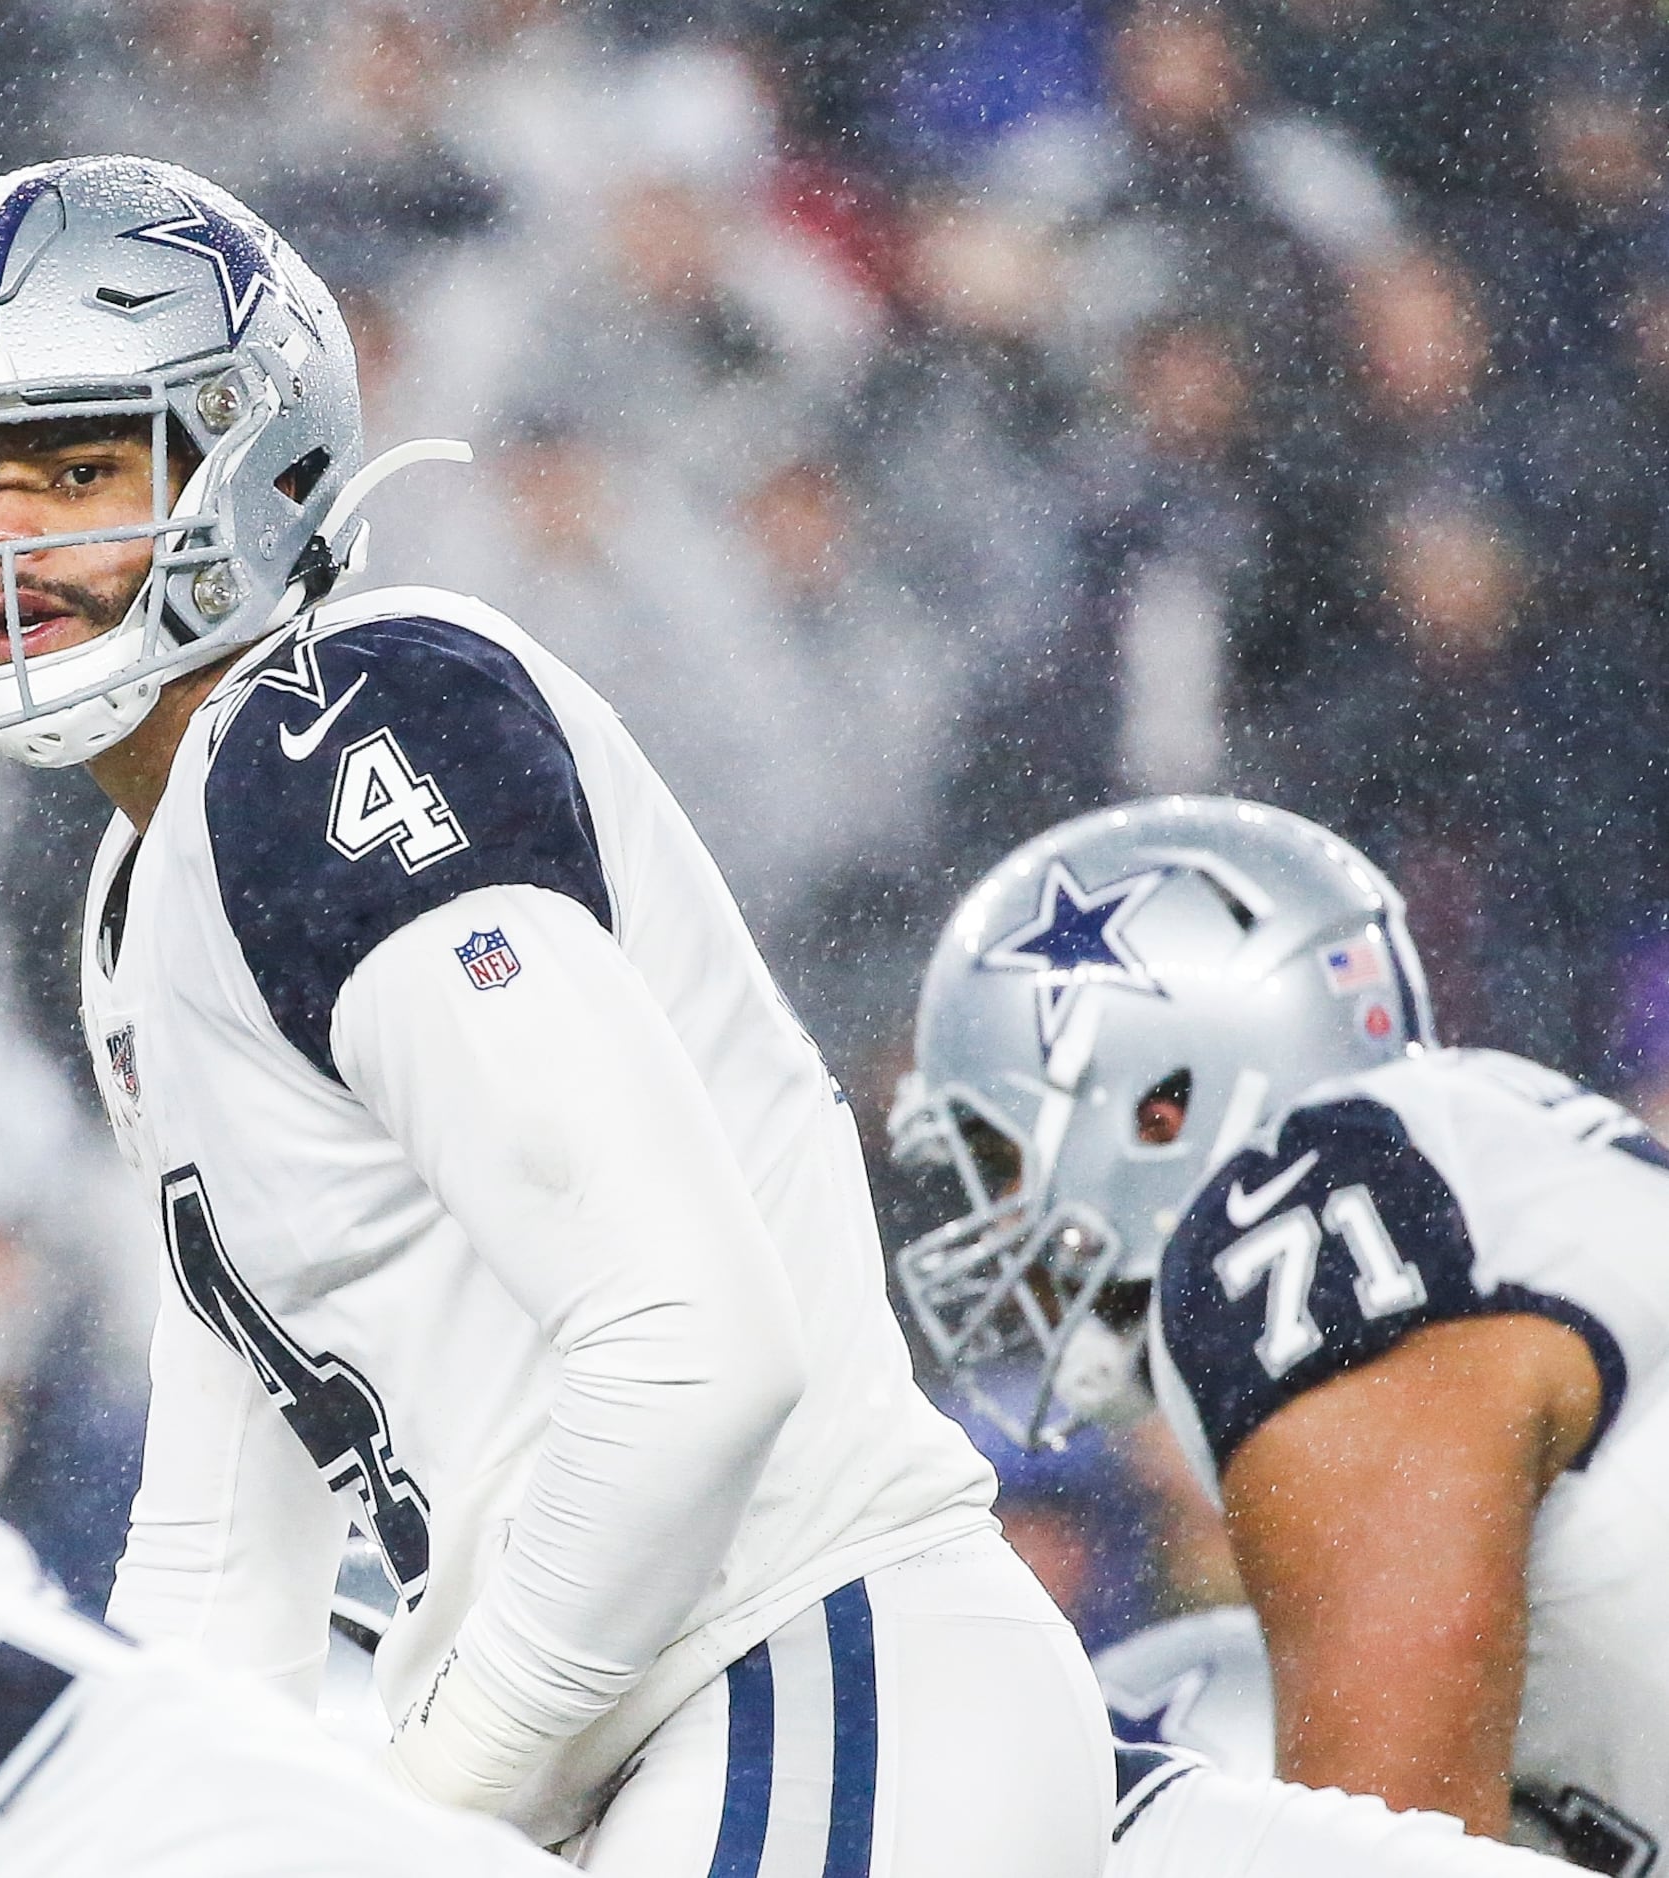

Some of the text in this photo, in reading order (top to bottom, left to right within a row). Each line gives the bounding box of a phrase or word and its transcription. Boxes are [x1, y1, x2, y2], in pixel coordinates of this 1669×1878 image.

[324, 724, 471, 877] 4
[470, 950, 516, 985] NFL
[1212, 1183, 1428, 1381] 71
[161, 1160, 431, 1613] 4
